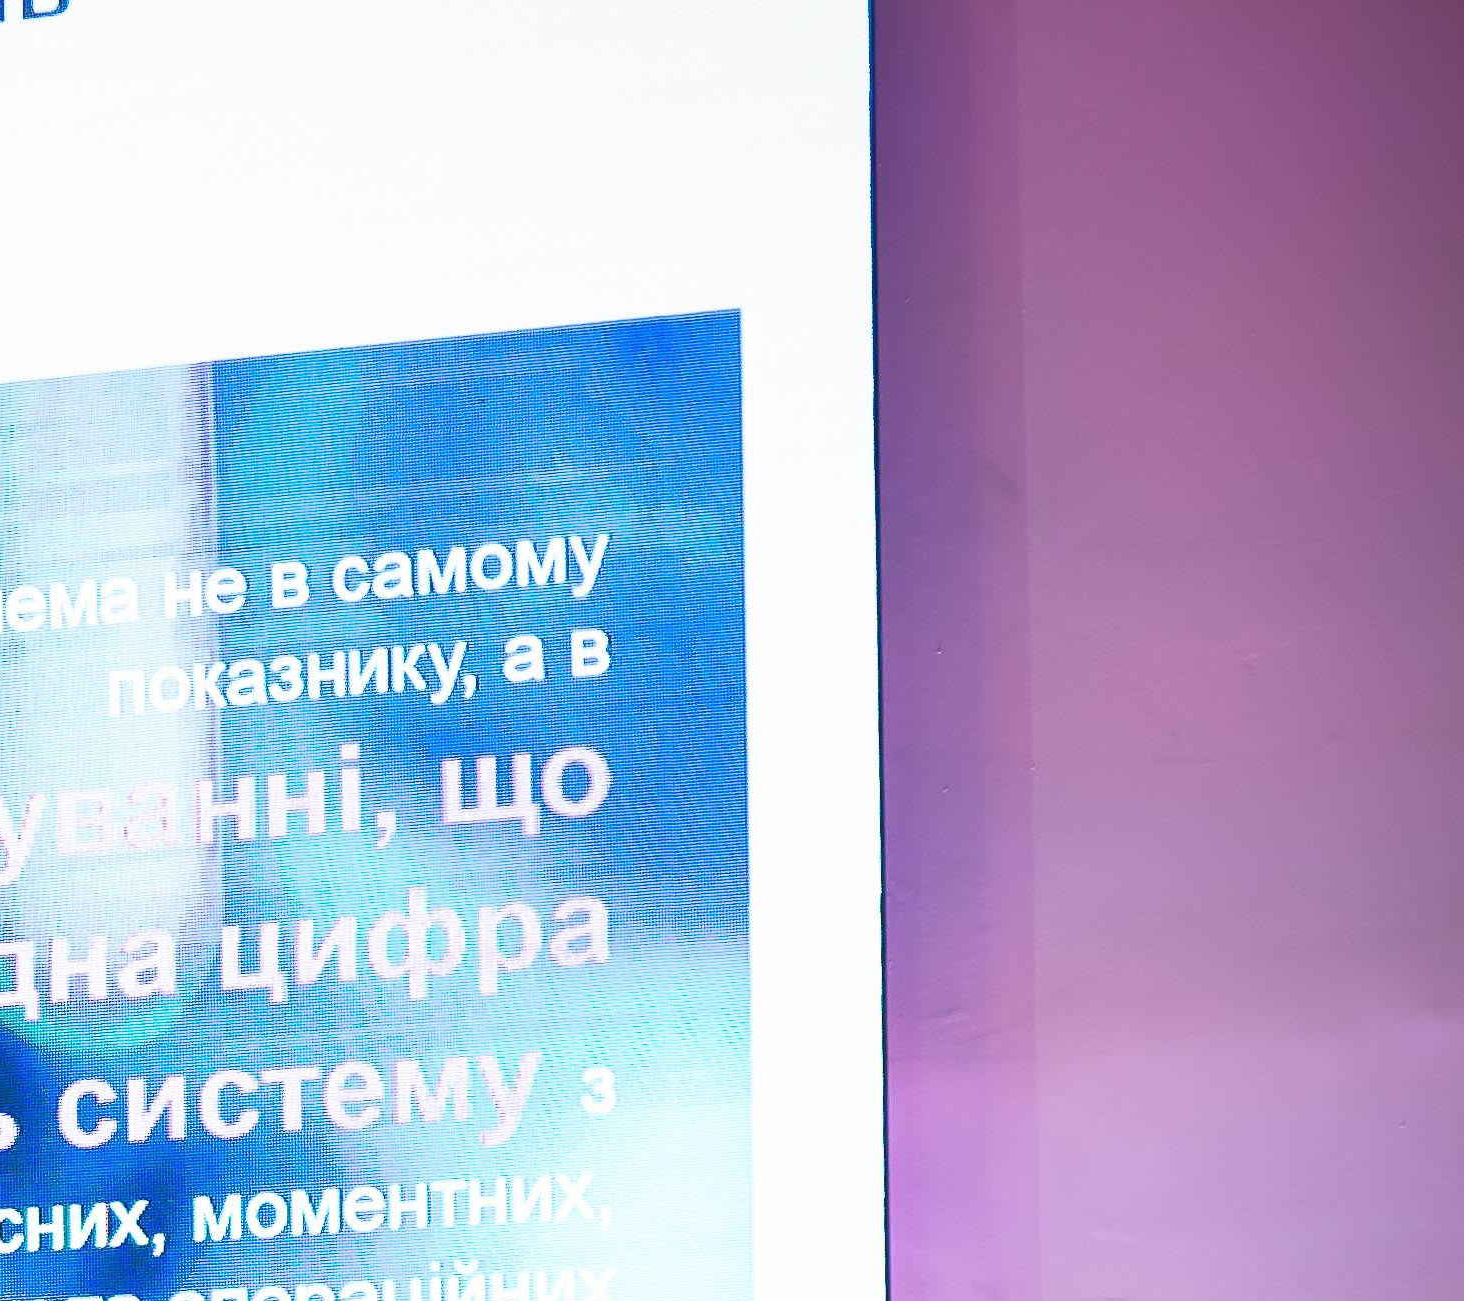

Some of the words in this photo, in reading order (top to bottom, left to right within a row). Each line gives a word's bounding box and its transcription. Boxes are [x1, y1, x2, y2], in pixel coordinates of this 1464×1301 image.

[159, 557, 251, 621] не
[270, 557, 312, 610] в
[331, 532, 611, 605] самому
[107, 636, 479, 720] показнику,
[500, 632, 548, 682] а
[568, 627, 613, 679] в
[442, 744, 611, 838] що
[217, 887, 610, 1004] цифра
[57, 1051, 542, 1149] систему
[580, 1067, 617, 1115] з
[191, 1170, 613, 1244] моментних,
